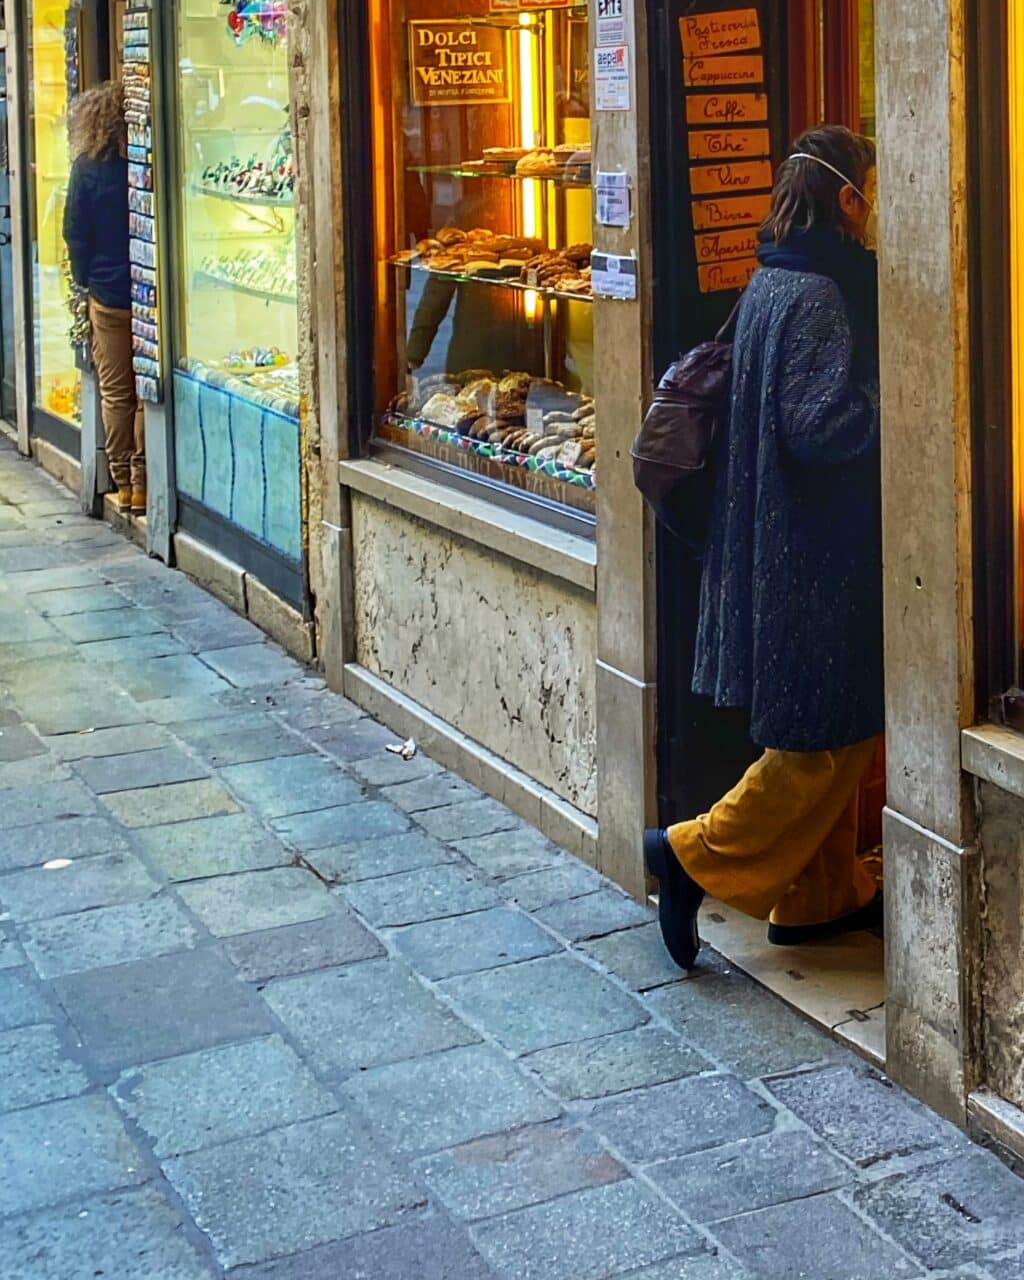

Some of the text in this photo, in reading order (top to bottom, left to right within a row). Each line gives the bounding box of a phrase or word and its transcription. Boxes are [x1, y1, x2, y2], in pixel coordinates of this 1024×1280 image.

[417, 28, 477, 47] DOLCI
[434, 48, 493, 67] TIPICI
[415, 66, 504, 86] VENEZIANI
[706, 167, 751, 186] Vino
